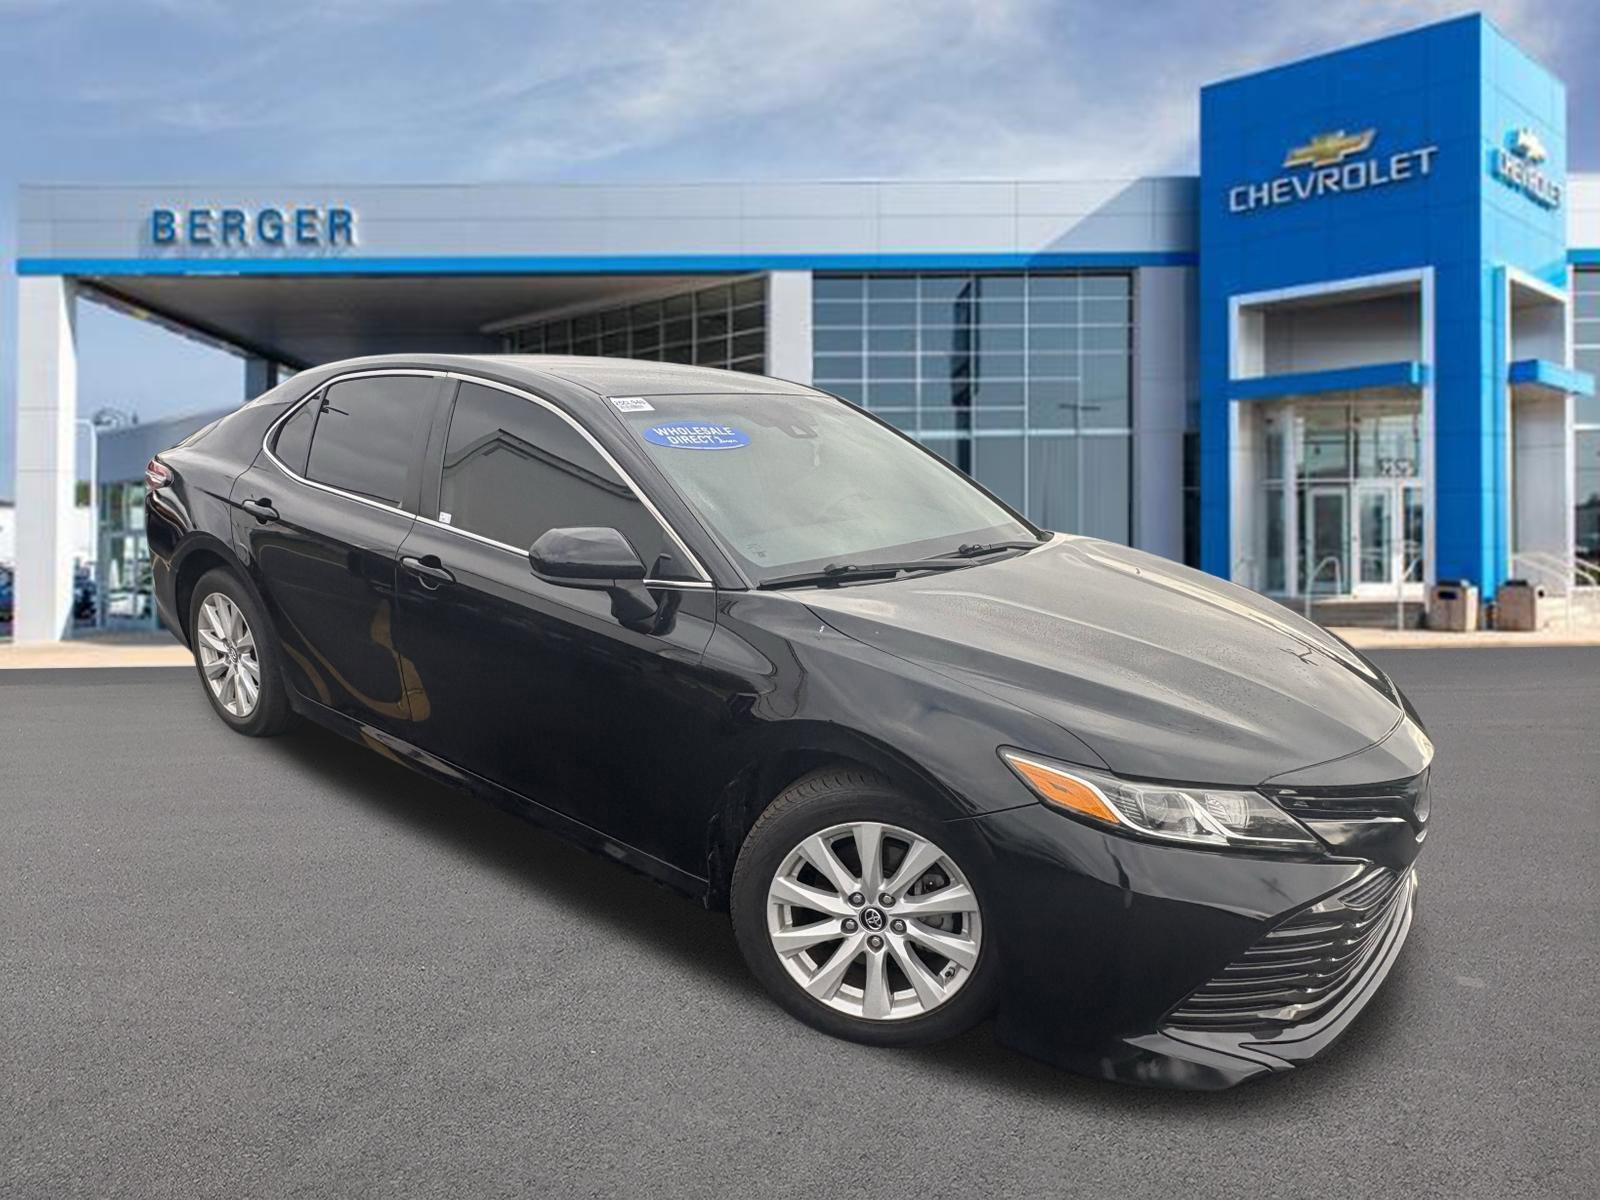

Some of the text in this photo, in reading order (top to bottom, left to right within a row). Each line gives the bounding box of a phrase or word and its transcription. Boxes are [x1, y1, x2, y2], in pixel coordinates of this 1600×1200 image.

[1229, 146, 1438, 213] CHEVROLET
[151, 207, 357, 246] BERGER
[652, 426, 736, 436] WHOLESALE
[666, 435, 716, 445] DIRECT
